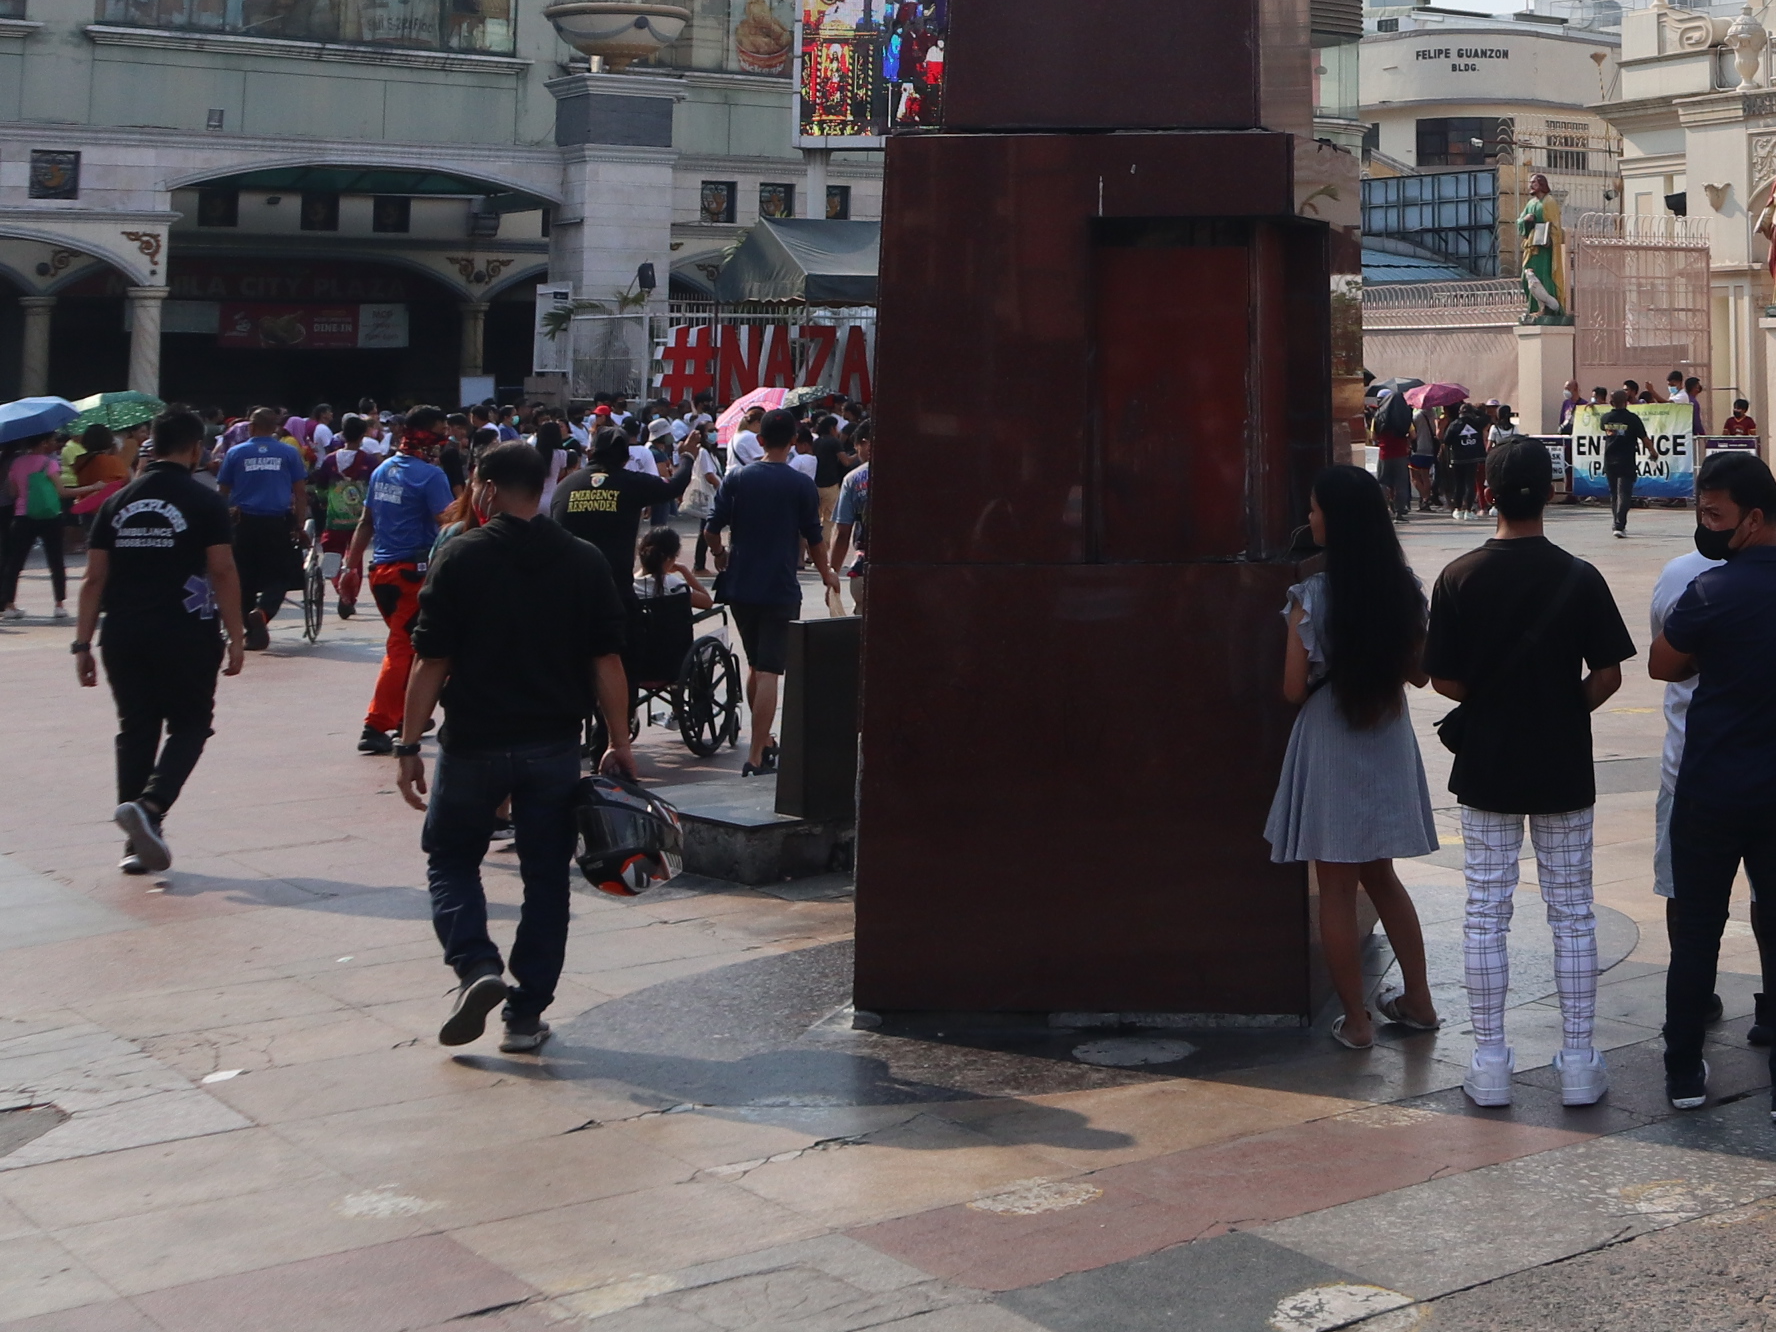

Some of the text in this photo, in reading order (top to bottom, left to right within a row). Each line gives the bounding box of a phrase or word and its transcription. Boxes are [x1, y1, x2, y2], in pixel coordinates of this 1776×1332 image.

[1416, 48, 1509, 60] FELIPE GUANZON
[1451, 64, 1479, 72] BLDG.
[239, 277, 303, 297] CITY
[569, 490, 620, 501] EMERGENCY
[567, 500, 617, 512] RESPONDER
[117, 527, 173, 536] AMBULANCE
